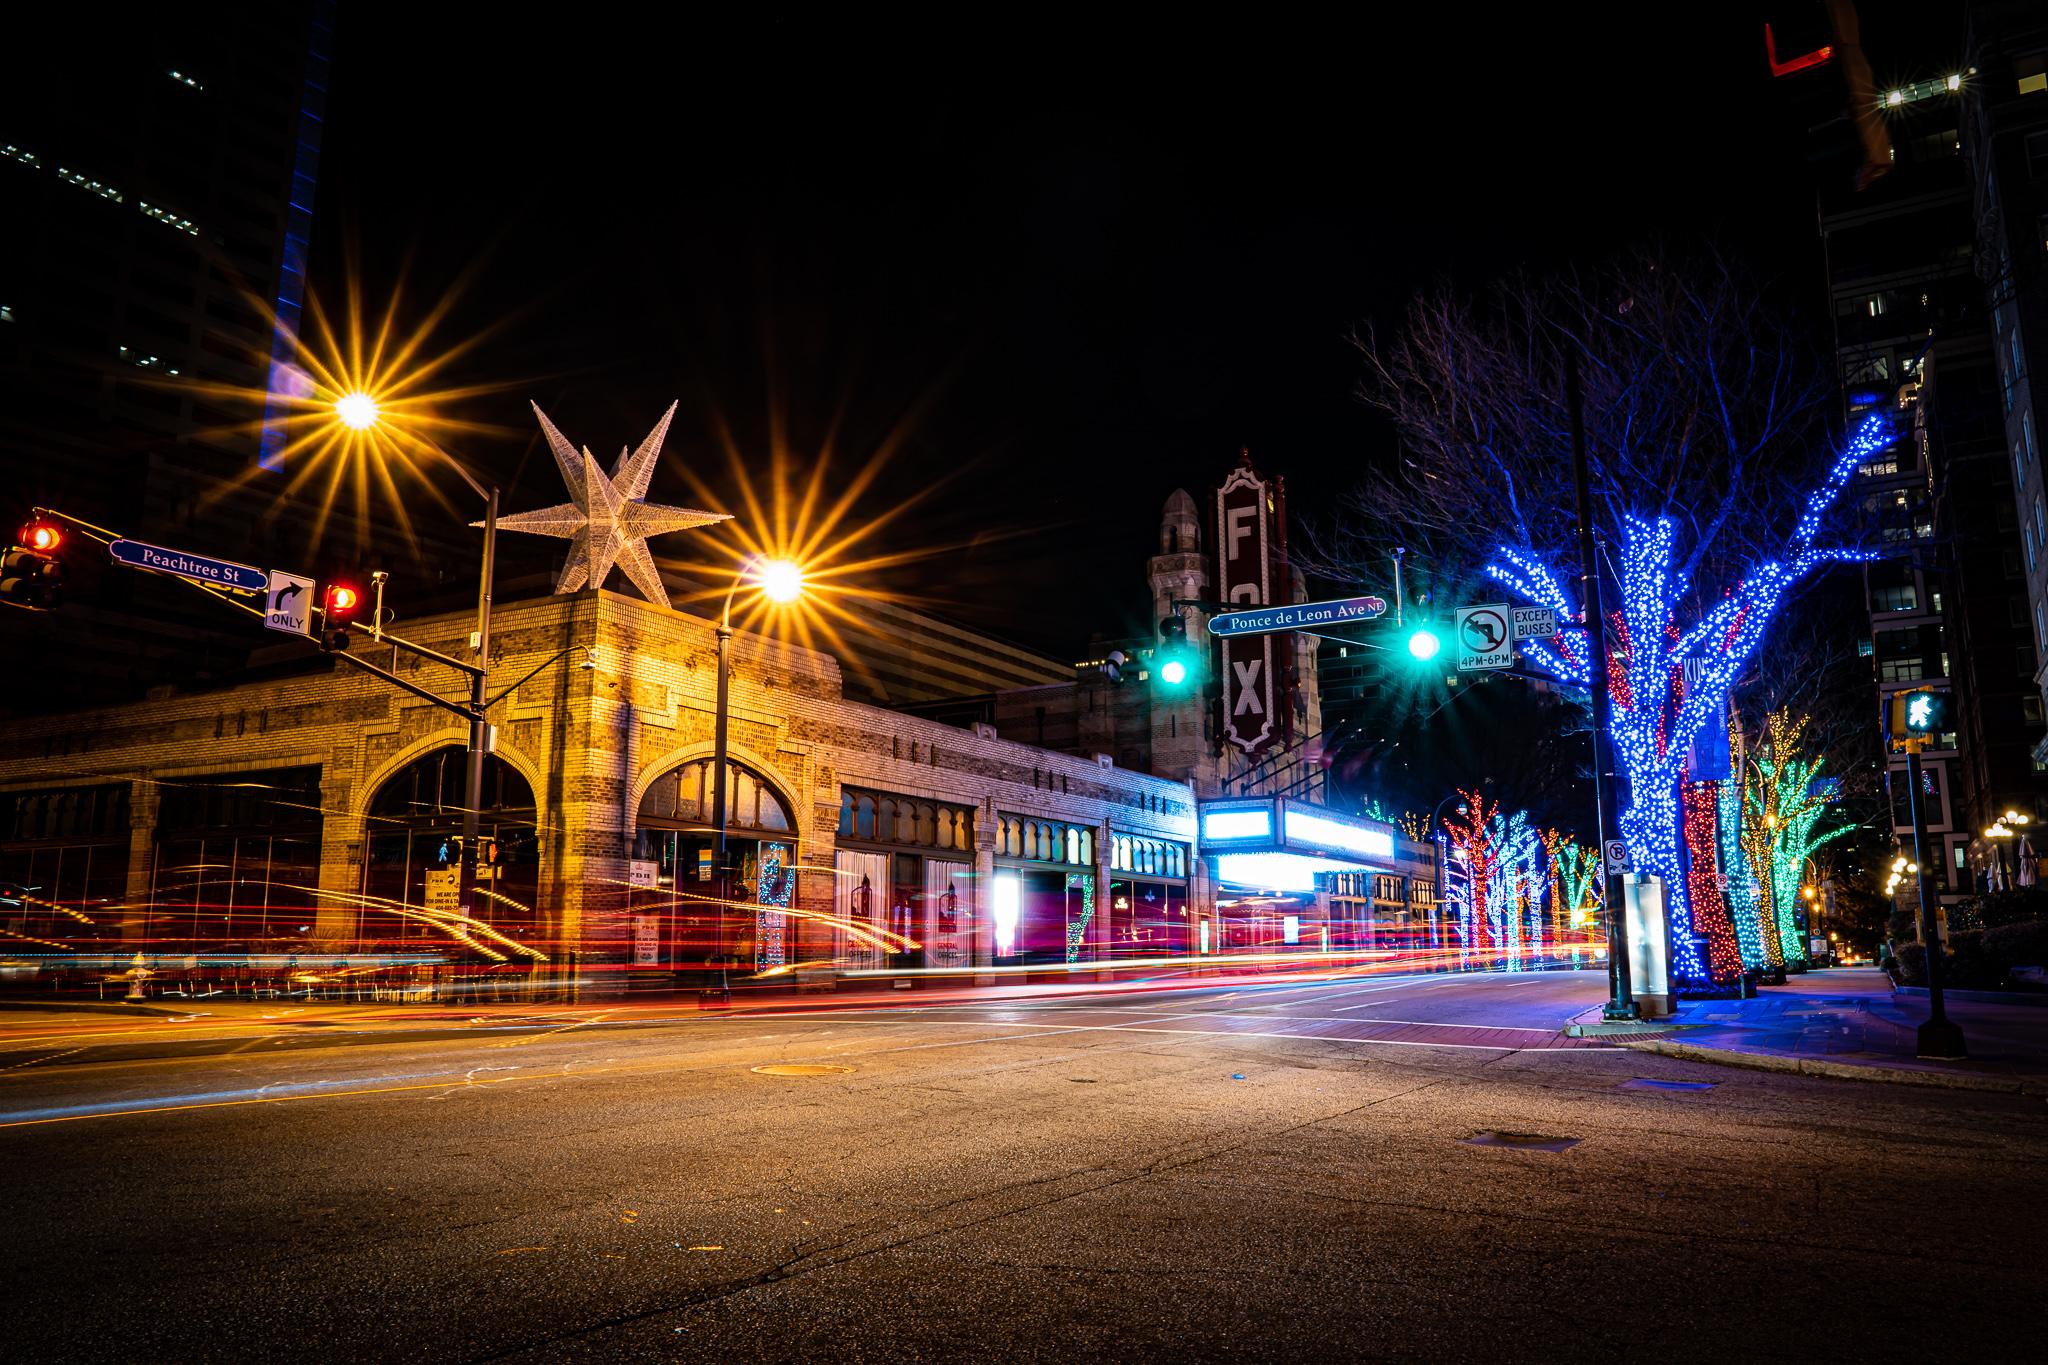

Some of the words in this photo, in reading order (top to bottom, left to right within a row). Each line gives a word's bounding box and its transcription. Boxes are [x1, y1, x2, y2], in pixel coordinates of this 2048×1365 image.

[142, 549, 219, 577] Peachtree
[223, 567, 240, 582] St
[272, 613, 304, 629] ONLY
[1231, 617, 1271, 630] Ponce
[1276, 612, 1293, 625] de
[1297, 609, 1332, 622] Leon
[1337, 605, 1365, 617] Ave
[1367, 602, 1383, 612] NE
[1515, 608, 1553, 623] EXCEPT
[1518, 623, 1553, 636] BUSES
[1461, 654, 1510, 667] 4PM-6PM
